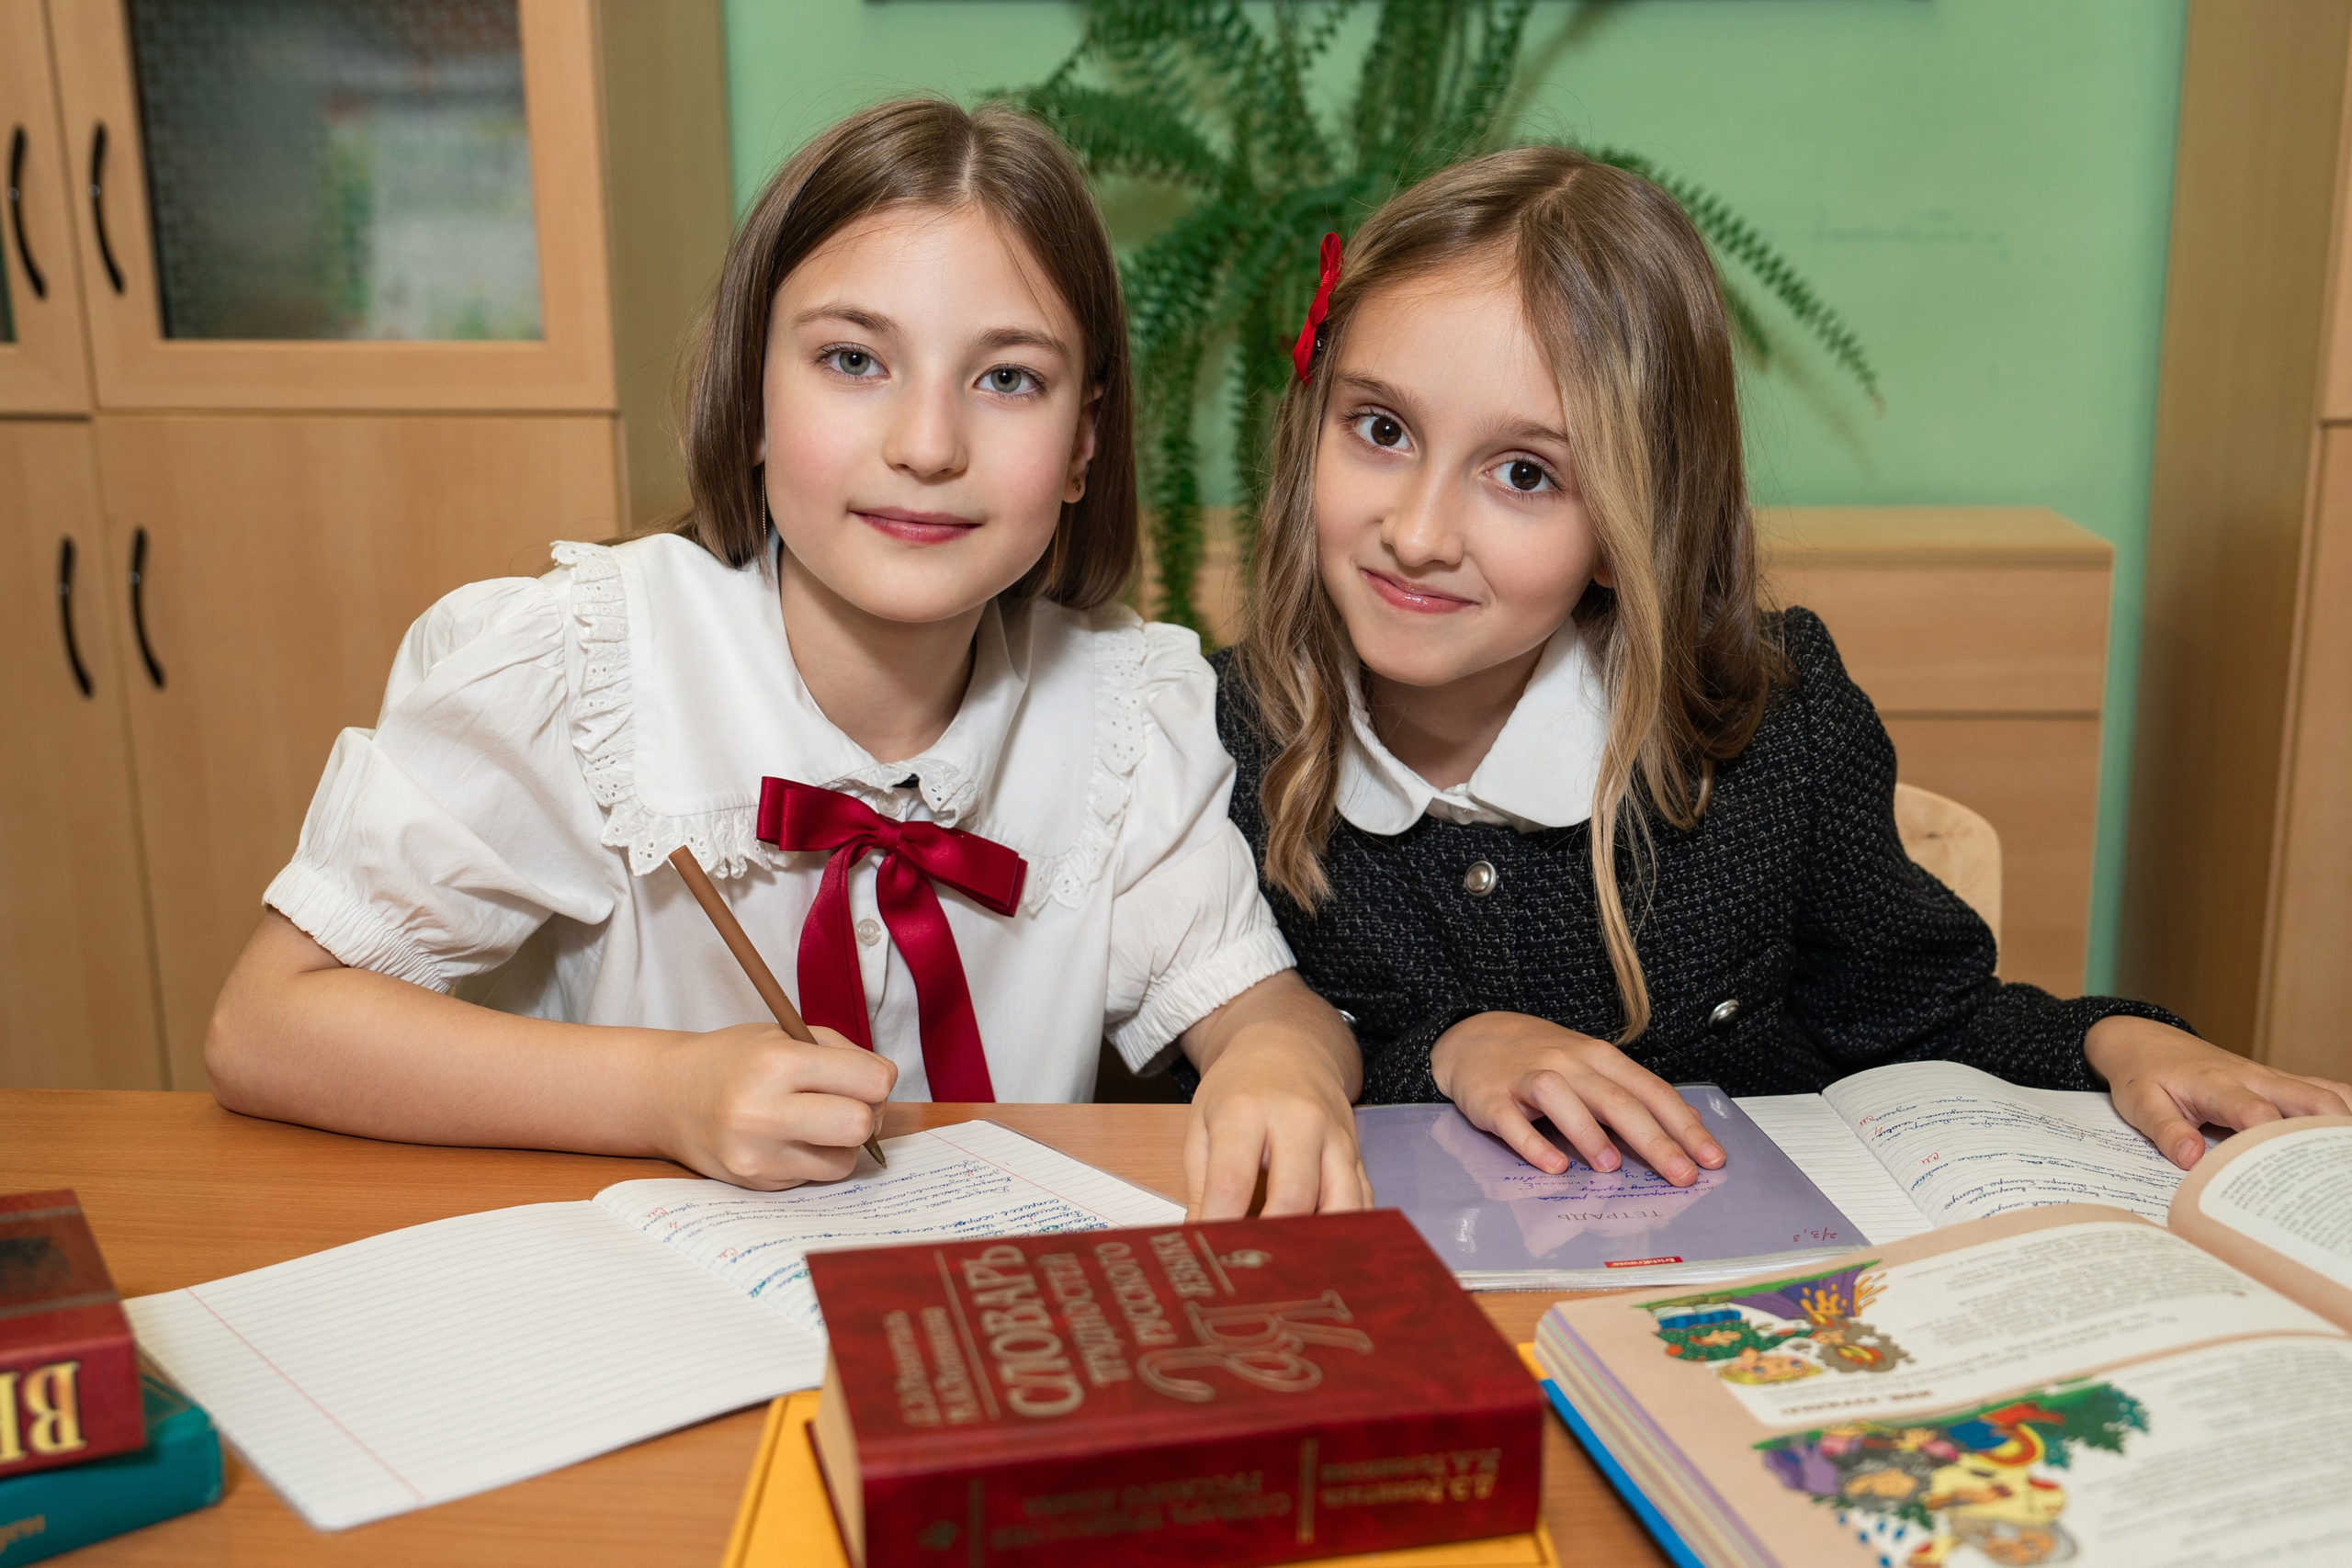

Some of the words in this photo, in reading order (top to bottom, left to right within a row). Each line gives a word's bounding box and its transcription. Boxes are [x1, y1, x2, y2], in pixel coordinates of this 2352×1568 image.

[1557, 1209, 1664, 1222] ТЕТРАДЬ
[1611, 1257, 1676, 1267] ErichKrause
[1093, 1241, 1178, 1348] РУССКОГО
[956, 1245, 1085, 1417] СЛОВАРЬ
